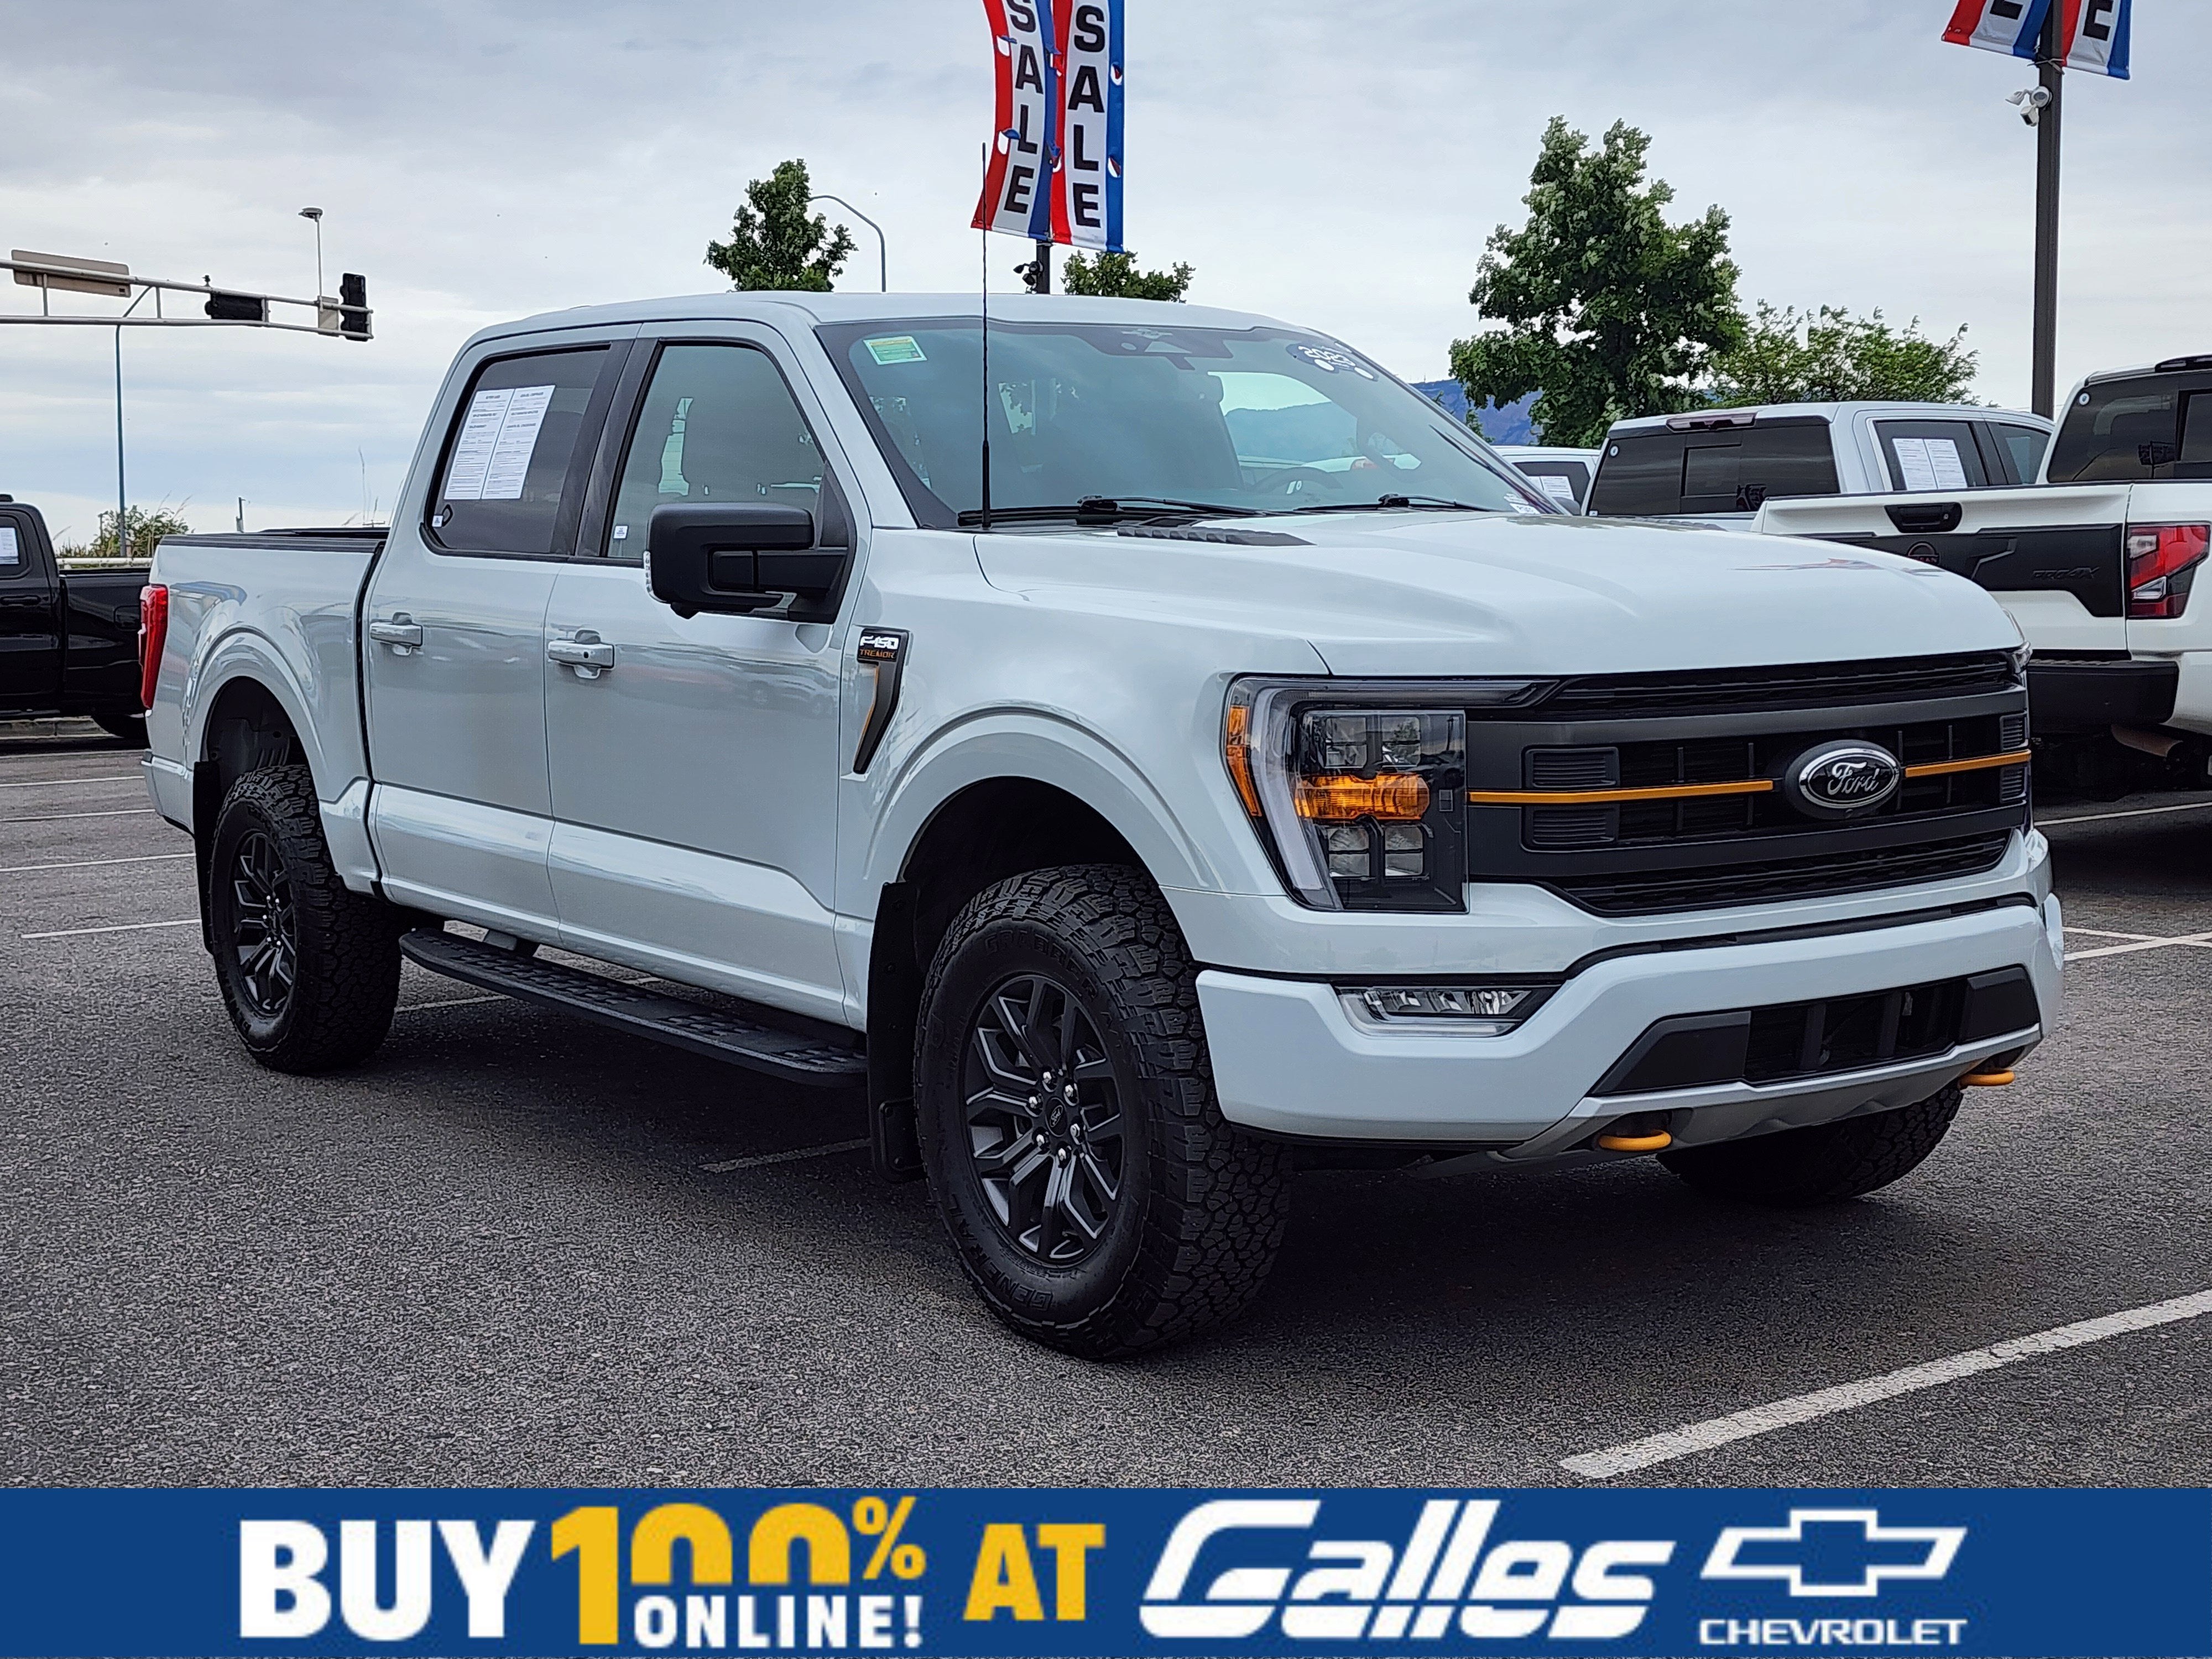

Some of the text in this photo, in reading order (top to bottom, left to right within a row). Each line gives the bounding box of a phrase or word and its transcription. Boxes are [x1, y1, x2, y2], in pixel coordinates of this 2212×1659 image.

[1004, 0, 1044, 214] SALE
[1067, 5, 1105, 228] SALE
[859, 649, 895, 659] TREMOR
[1827, 761, 1880, 795] Ford
